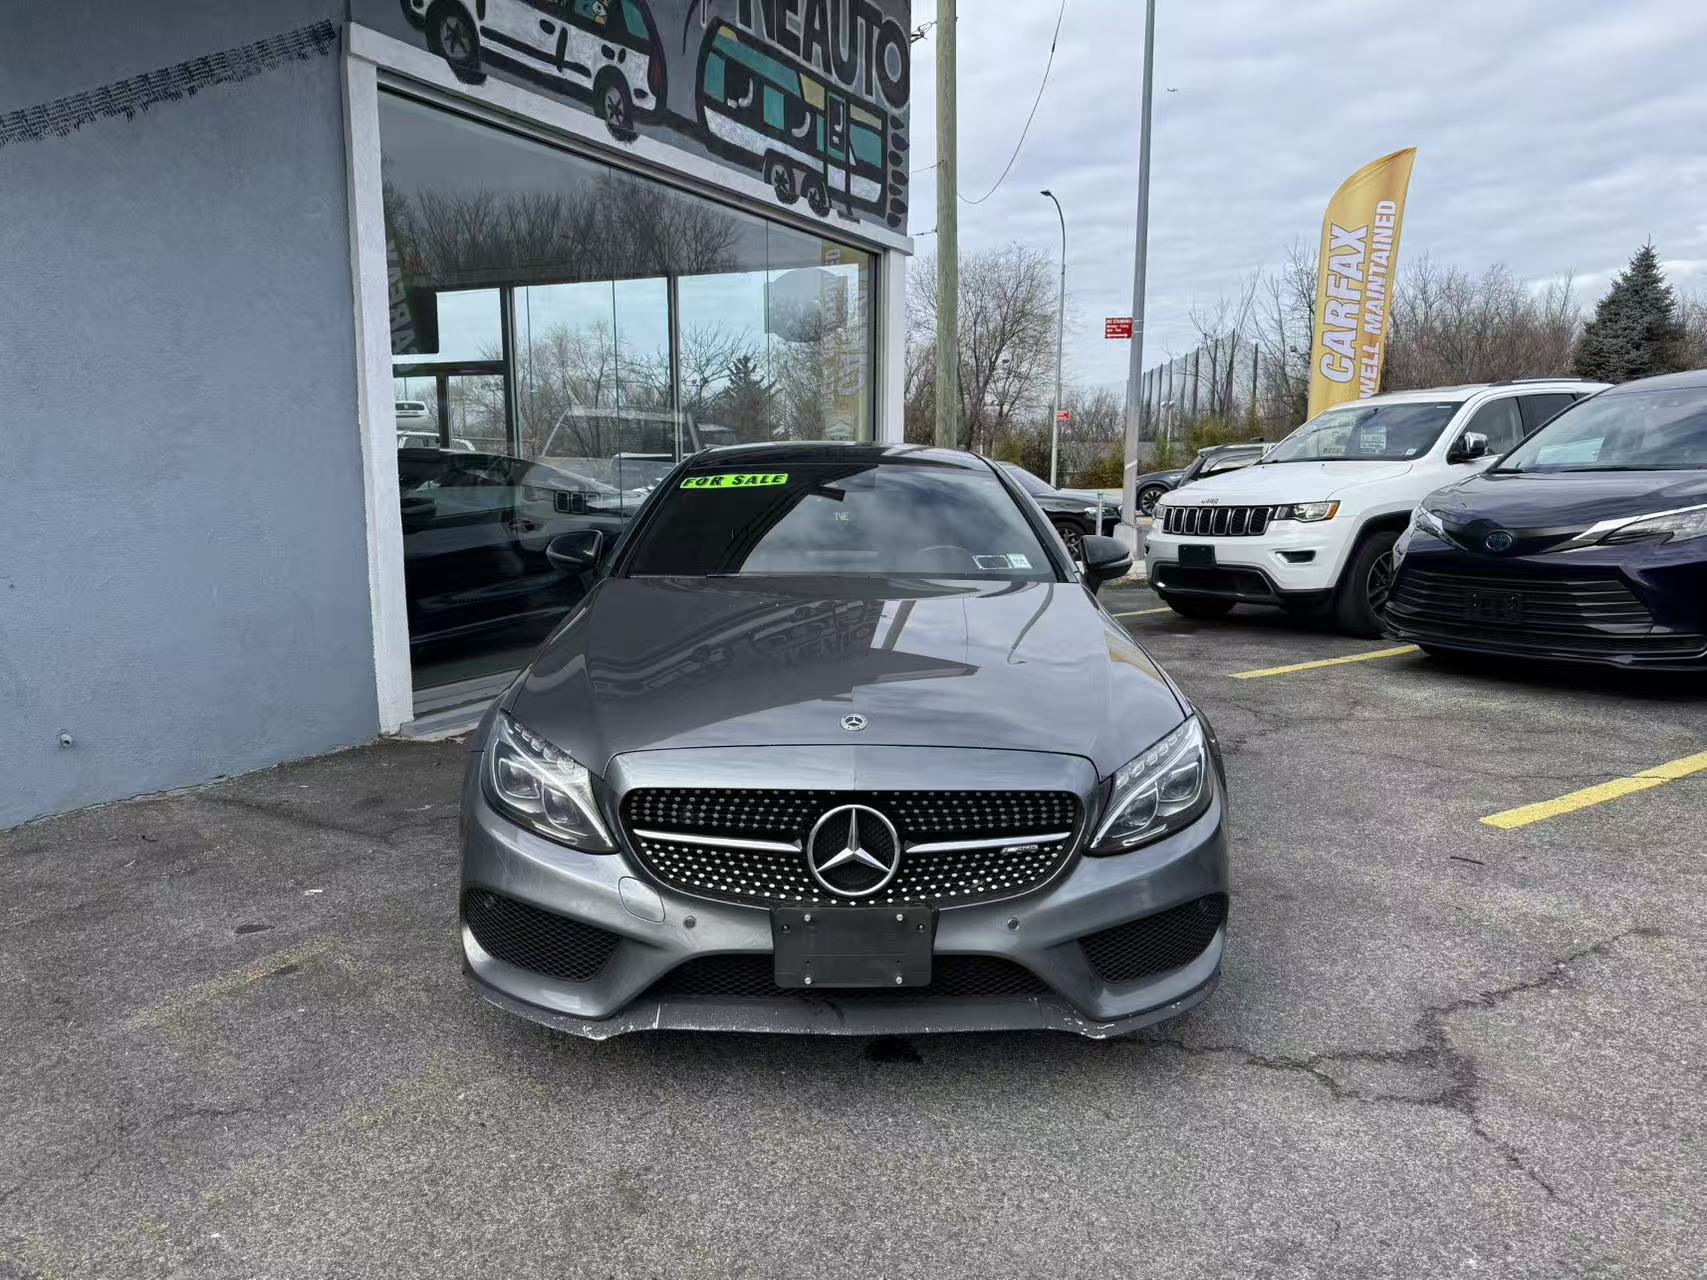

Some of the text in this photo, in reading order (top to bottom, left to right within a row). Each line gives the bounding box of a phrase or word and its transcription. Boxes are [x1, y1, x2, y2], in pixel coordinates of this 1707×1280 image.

[1319, 222, 1369, 384] CARFAX
[1364, 200, 1397, 336] MAINTAINED
[1360, 341, 1380, 399] WELL
[683, 474, 786, 487] FOR SALE
